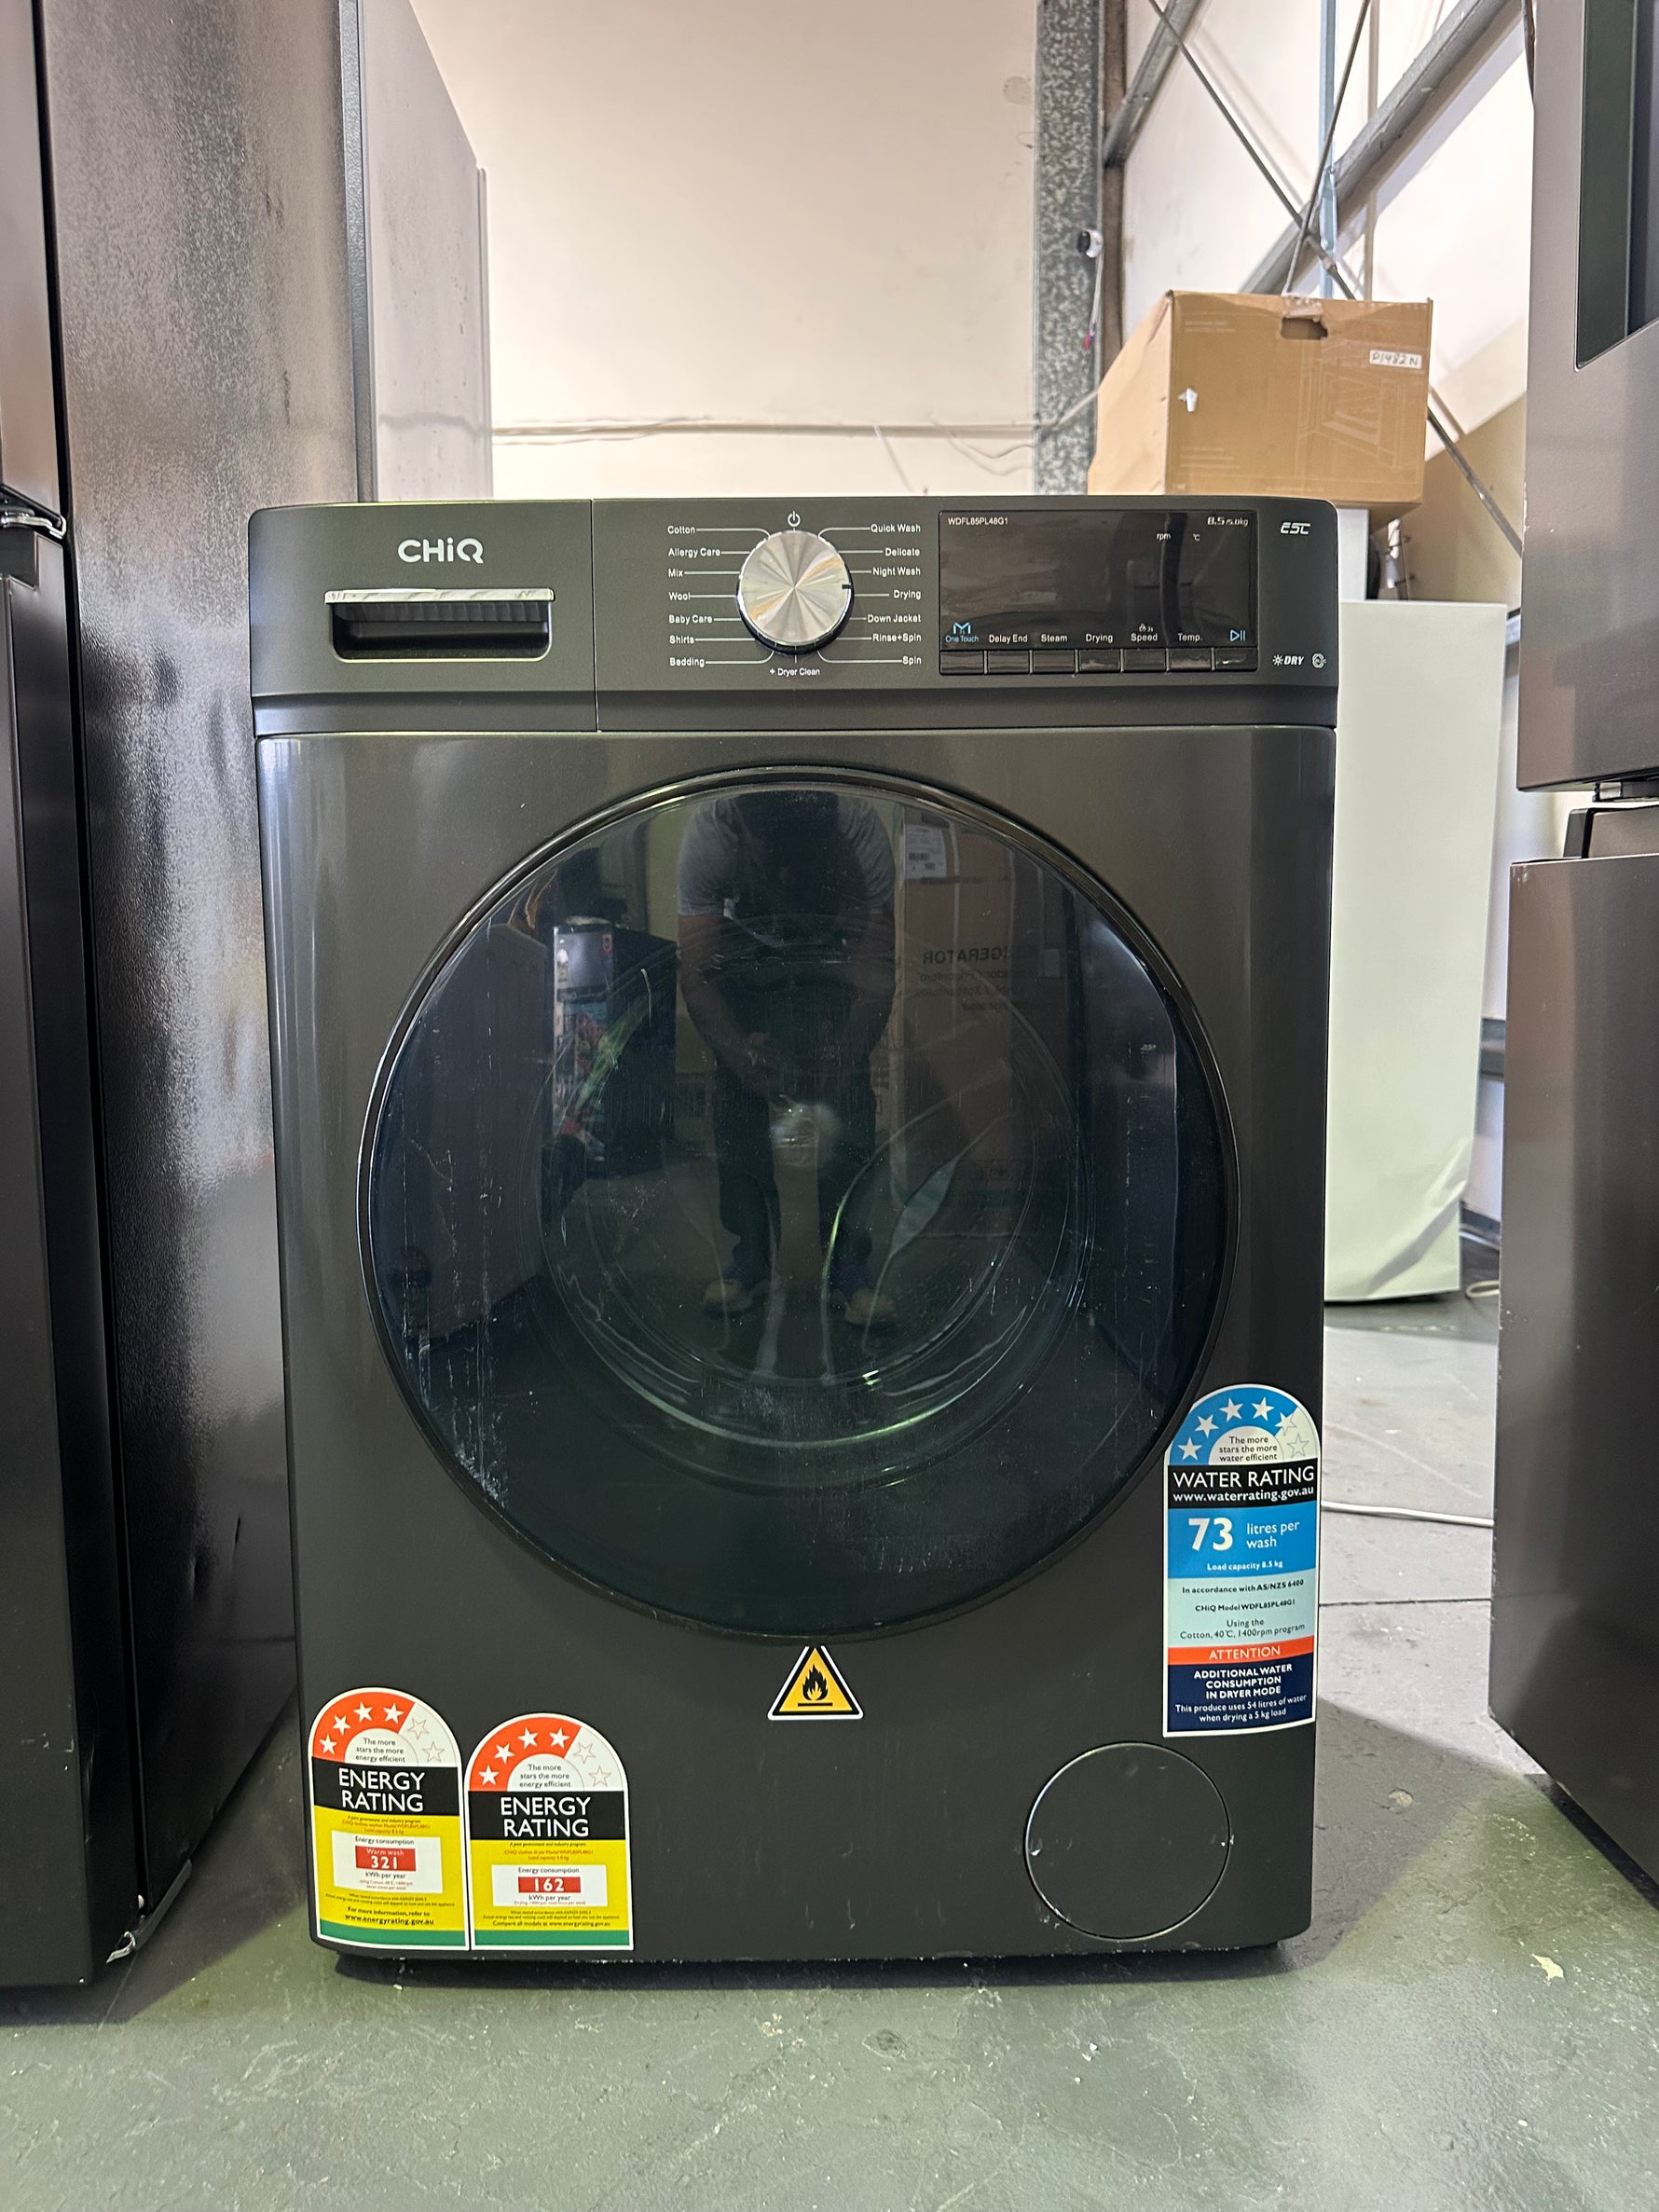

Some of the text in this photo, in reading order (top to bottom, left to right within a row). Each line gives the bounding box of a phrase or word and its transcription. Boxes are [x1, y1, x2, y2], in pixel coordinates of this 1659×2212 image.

[948, 517, 1008, 526] WDFL85PL48G1
[667, 526, 695, 534] Cotton
[871, 524, 921, 533] Quick Wash
[398, 537, 485, 564] CHiQ
[668, 548, 720, 557] Allergy Care
[885, 548, 920, 556] Delicate
[872, 568, 896, 577] Night
[669, 592, 691, 600] Wool
[894, 590, 921, 600] Drying
[669, 615, 712, 625] Baby Care
[868, 614, 921, 623] Down Jacket
[669, 635, 694, 644] Shirts
[872, 634, 921, 643] Rinse+Spin
[945, 635, 959, 643] One
[989, 634, 1028, 643] Delay End
[1041, 634, 1067, 642] Steam
[1086, 634, 1114, 643] Drying
[1131, 633, 1158, 642] Speed
[670, 658, 705, 667] Bedding
[902, 656, 922, 666] Spin
[1284, 656, 1304, 666] DRY
[778, 668, 798, 677] Dryer
[1173, 1466, 1314, 1488] WATER RATING
[1173, 1487, 1314, 1502] www.waterrating.gov.au
[1247, 1521, 1300, 1535] litres per
[1188, 1518, 1233, 1551] 73
[1247, 1536, 1277, 1549] wash
[1228, 1562, 1260, 1572] capacity
[1274, 1560, 1283, 1569] kg
[1192, 1586, 1237, 1594] accordance
[1256, 1581, 1286, 1590] AS/NZS
[1227, 1619, 1250, 1628] Using
[1238, 1628, 1272, 1638] 1400rpm
[1274, 1624, 1305, 1634] program
[1209, 1645, 1282, 1660] ATTENTION
[1194, 1664, 1293, 1679] ADDITIONAL WATER
[1206, 1676, 1282, 1689] CONSUMPTION
[1219, 1689, 1251, 1698] DRYER
[1254, 1686, 1282, 1697] MODE
[1194, 1704, 1227, 1713] produce
[1247, 1701, 1256, 1710] 54
[1287, 1695, 1307, 1704] water
[1223, 1711, 1246, 1722] drying
[1261, 1711, 1269, 1719] kg
[1271, 1709, 1286, 1717] load
[339, 1768, 425, 1791] ENERGY
[342, 1790, 424, 1812] RATING
[500, 1797, 591, 1816] ENERGY
[504, 1819, 589, 1837] RATING
[355, 1835, 375, 1844] Energy
[371, 1855, 397, 1870] 321
[535, 1878, 564, 1892] 162
